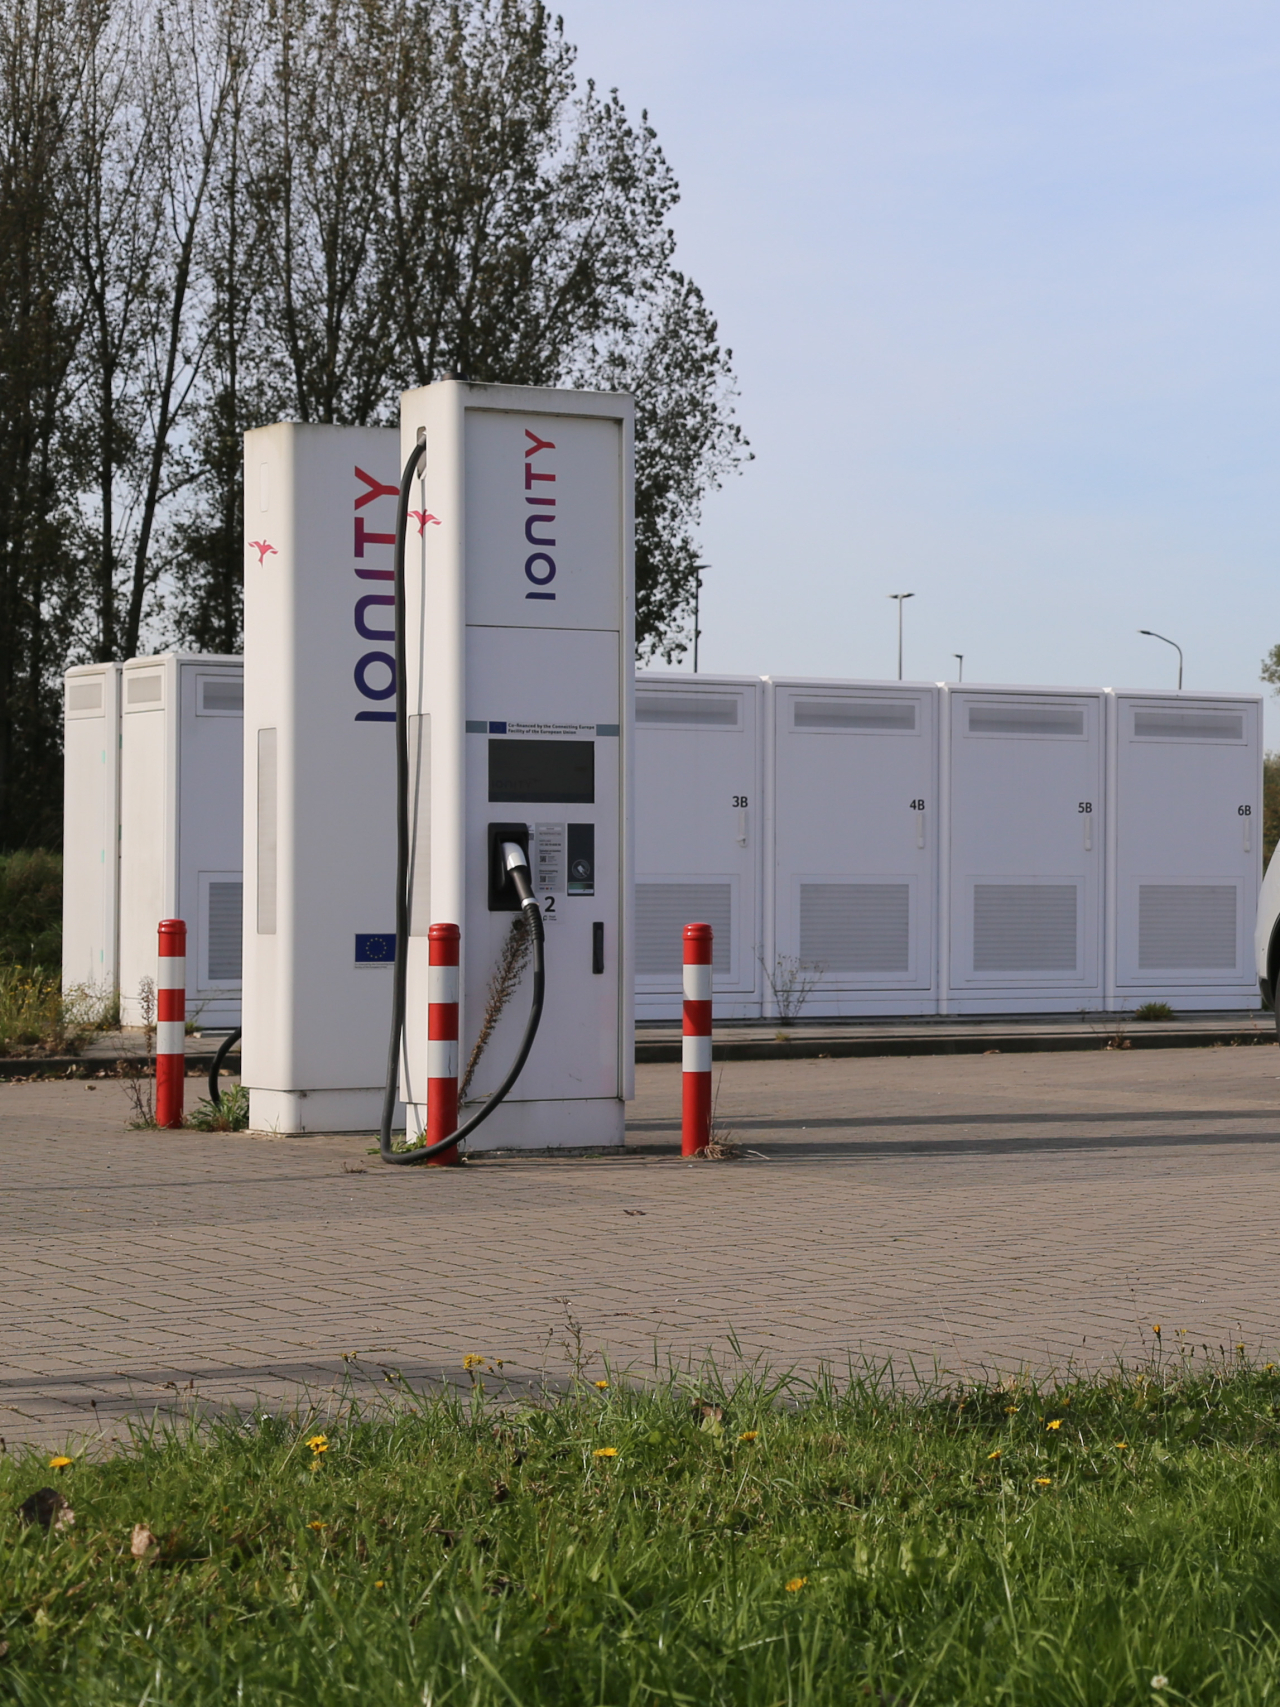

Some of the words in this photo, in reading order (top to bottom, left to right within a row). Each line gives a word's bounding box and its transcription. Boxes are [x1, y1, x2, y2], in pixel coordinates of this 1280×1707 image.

[525, 428, 556, 600] IONITY
[354, 465, 400, 721] IONITY
[732, 796, 748, 809] 3B
[910, 799, 926, 811] 4B
[1078, 802, 1093, 814] 5B
[1238, 805, 1252, 816] 6B
[544, 896, 556, 912] 2
